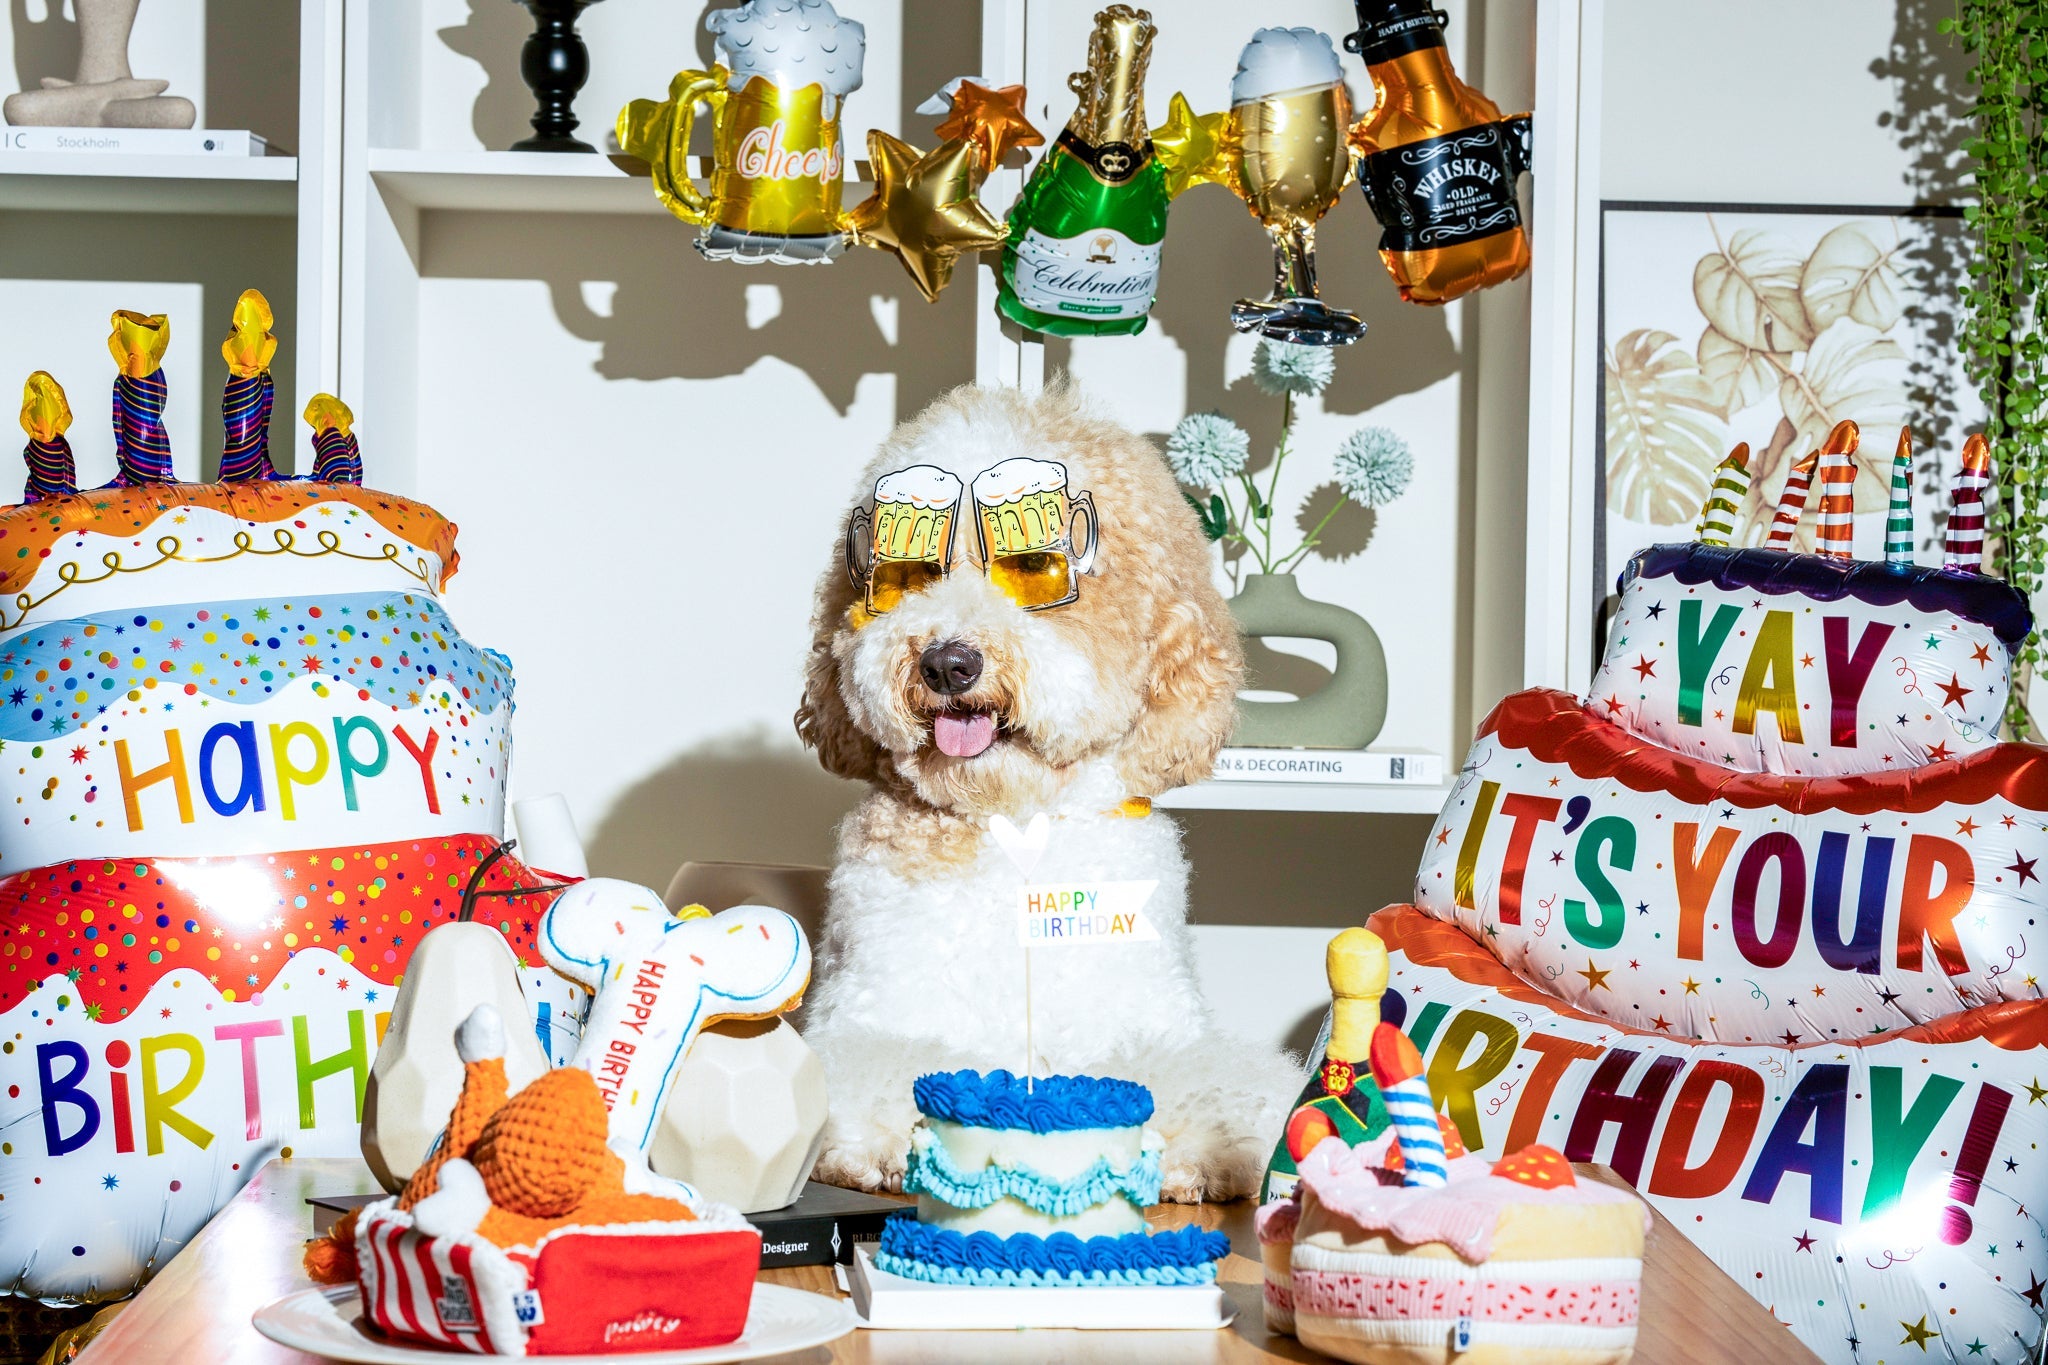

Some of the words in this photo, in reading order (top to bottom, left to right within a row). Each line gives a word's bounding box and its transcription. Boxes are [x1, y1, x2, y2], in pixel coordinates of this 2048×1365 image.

[1378, 22, 1405, 38] HAPPY
[56, 135, 120, 149] Stockholm
[738, 120, 840, 184] Cheers
[1413, 158, 1502, 199] WHISKEY
[1455, 193, 1491, 208] FRAGRANCE
[1456, 205, 1477, 216] DRINK
[1032, 258, 1153, 294] Celebration
[1677, 599, 1896, 748] YAY
[1234, 759, 1244, 770] &
[1248, 759, 1342, 773] DECORATING
[1454, 780, 1637, 950] IT'S
[1673, 821, 1976, 976] YOUR
[1028, 890, 1098, 913] HAPPY
[1029, 913, 1136, 938] BIRTHDAY
[620, 960, 666, 1035] HAPPY
[762, 1241, 809, 1255] Designer
